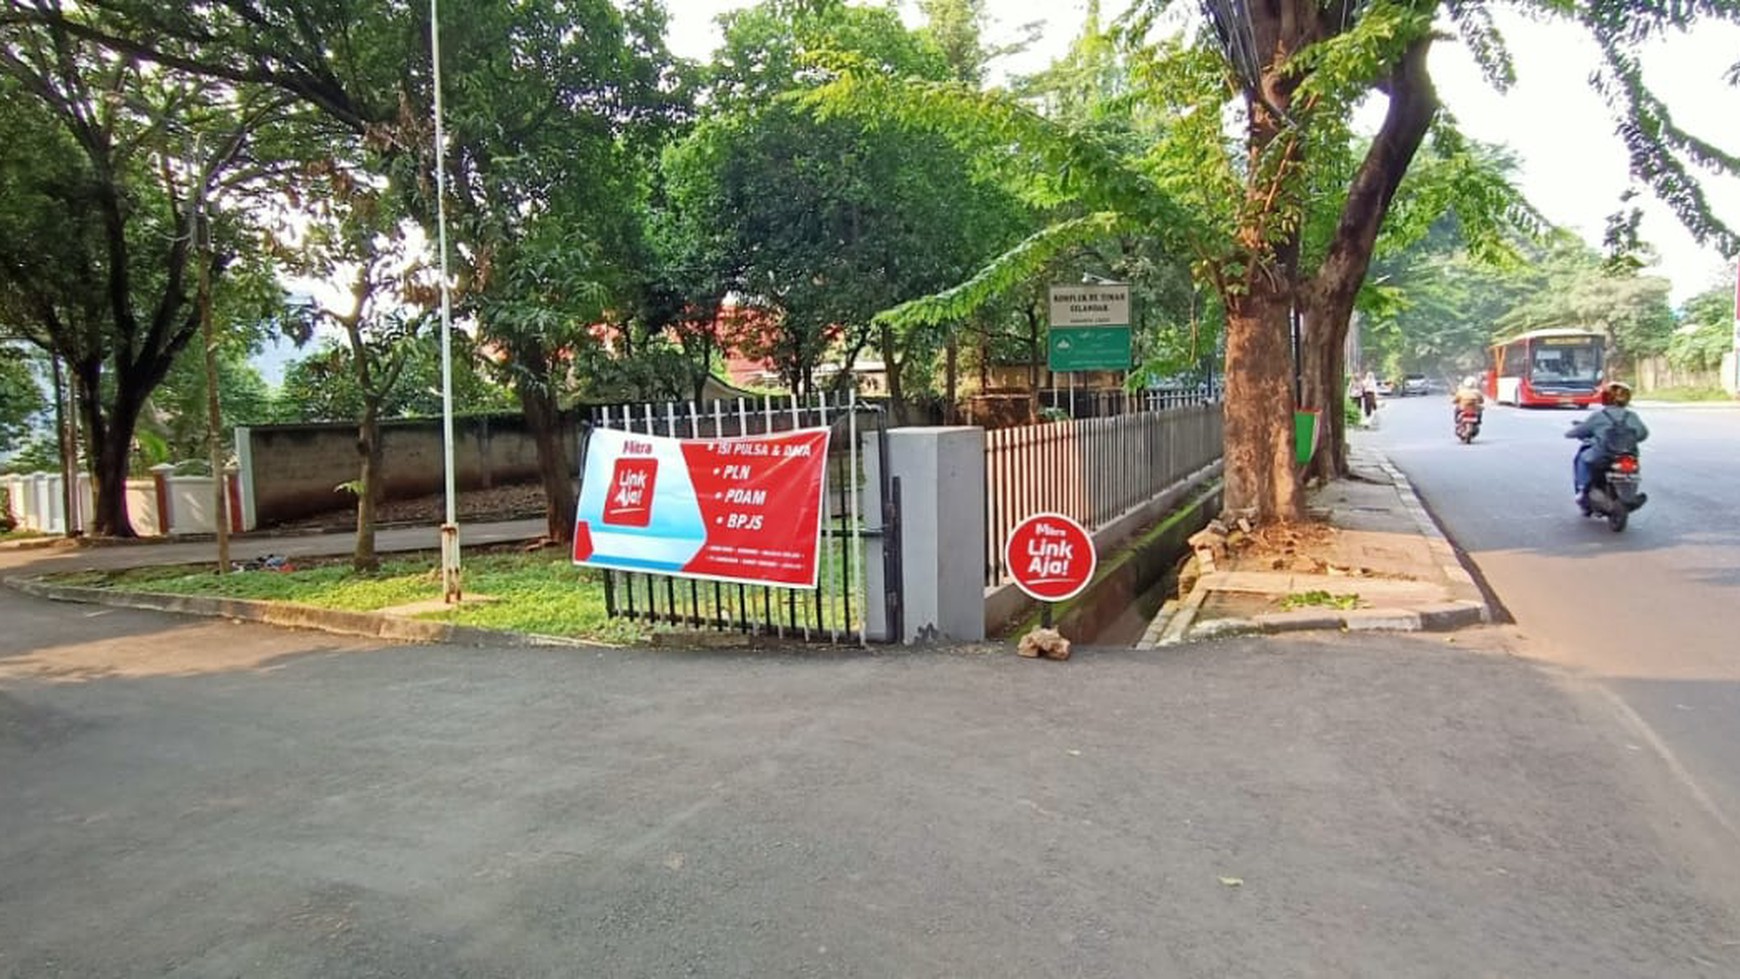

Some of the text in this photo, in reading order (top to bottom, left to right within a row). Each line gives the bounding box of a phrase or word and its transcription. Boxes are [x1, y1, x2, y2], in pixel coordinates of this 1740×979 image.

[623, 440, 652, 454] Mitra
[718, 441, 732, 455] ISI
[734, 442, 769, 456] PULSA
[771, 444, 781, 456] &
[619, 468, 648, 489] Link
[723, 465, 751, 479] PLN
[614, 487, 642, 507] Aja!
[724, 489, 767, 505] PDAM
[727, 513, 764, 530] BPJS
[1028, 538, 1073, 560] Link
[1028, 556, 1069, 577] Aja!
